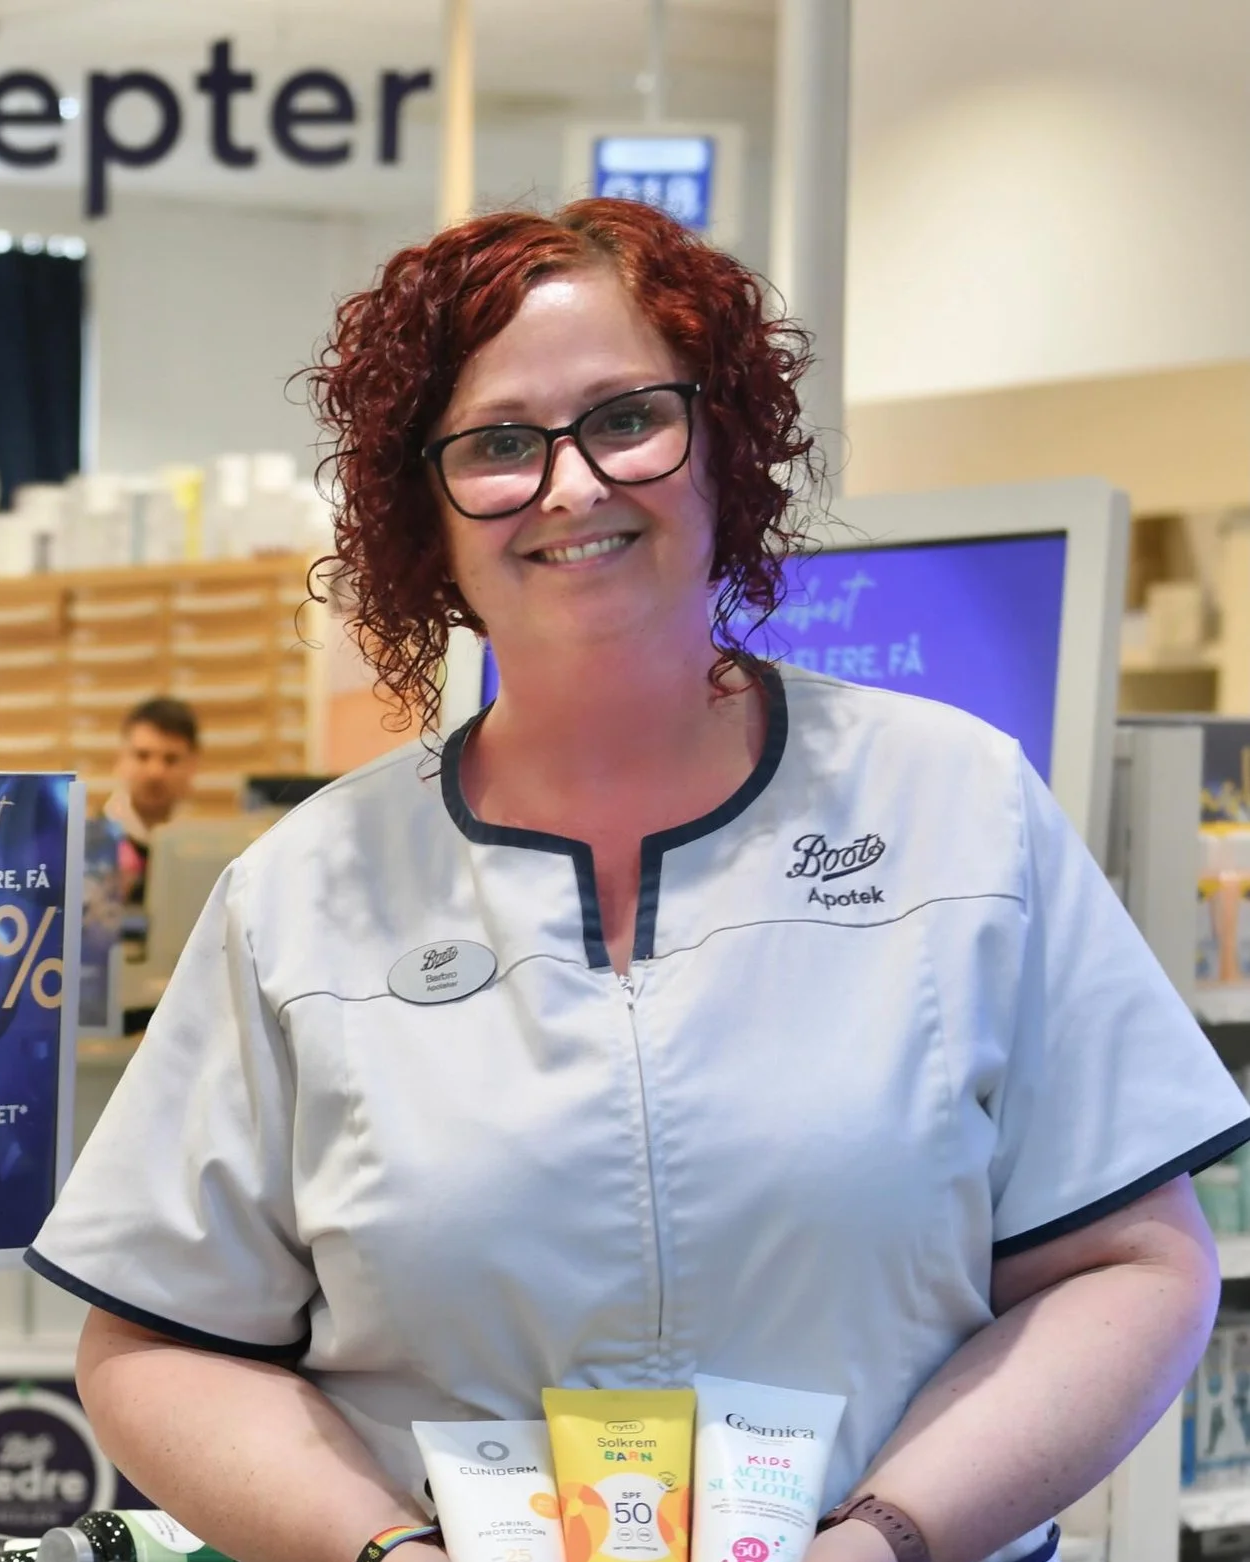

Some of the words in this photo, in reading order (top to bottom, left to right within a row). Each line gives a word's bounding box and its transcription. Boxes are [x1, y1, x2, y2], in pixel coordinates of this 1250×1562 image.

[786, 833, 886, 882] Boots
[26, 863, 50, 889] FÅ
[807, 886, 885, 909] Apotek
[420, 946, 458, 972] Boots
[725, 1412, 816, 1441] Cosmica
[597, 1437, 657, 1449] Solkrem
[604, 1450, 654, 1462] BARN
[747, 1455, 791, 1469] KIDS
[459, 1465, 538, 1476] CLINIDERM
[622, 1491, 642, 1499] SPF
[615, 1502, 652, 1524] 50
